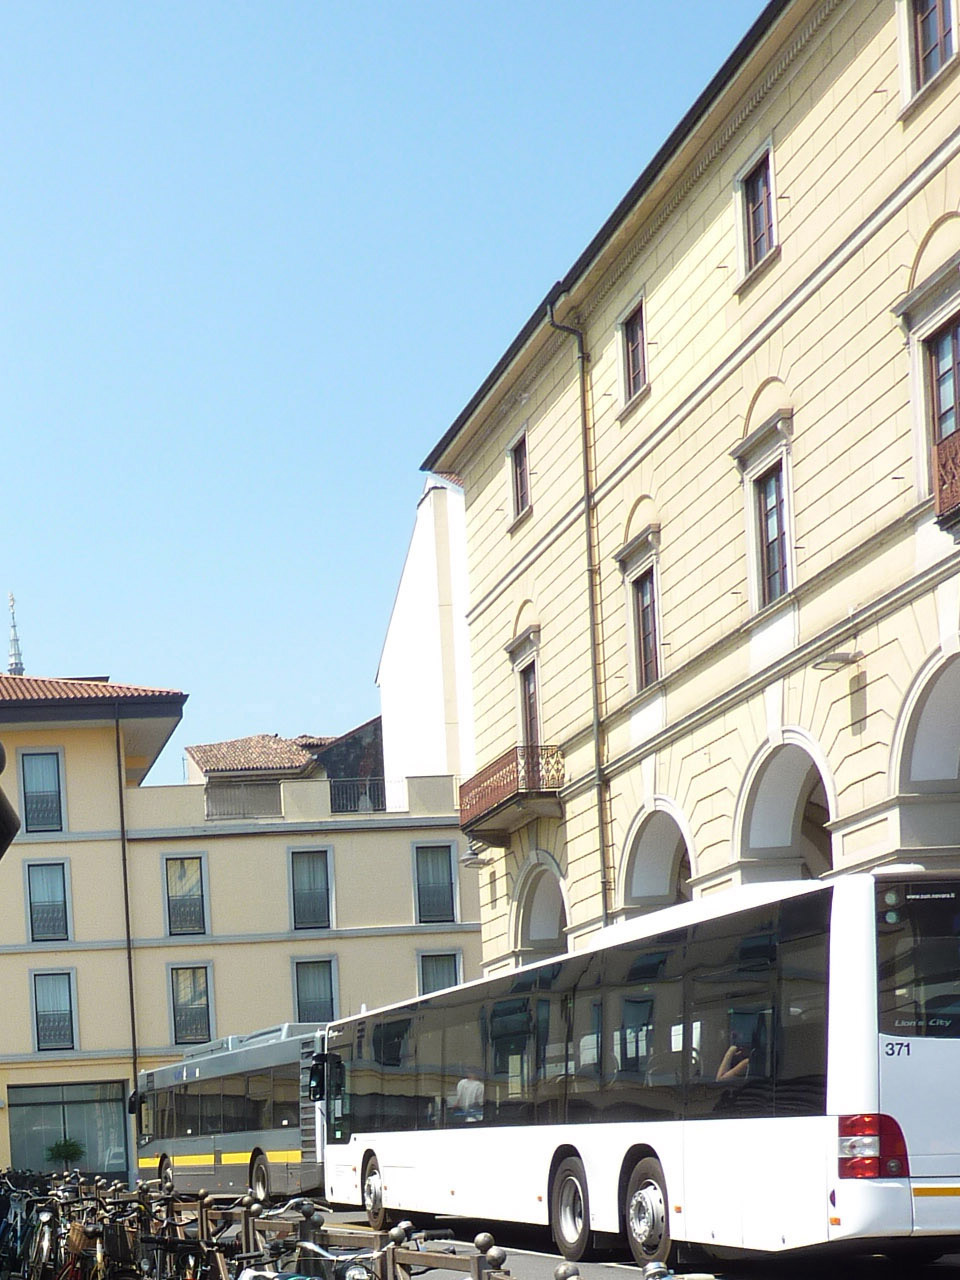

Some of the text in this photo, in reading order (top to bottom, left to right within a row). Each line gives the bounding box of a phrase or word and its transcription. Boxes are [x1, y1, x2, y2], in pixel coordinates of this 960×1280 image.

[895, 1018, 952, 1027] Lion's City
[885, 1042, 910, 1056] 371
